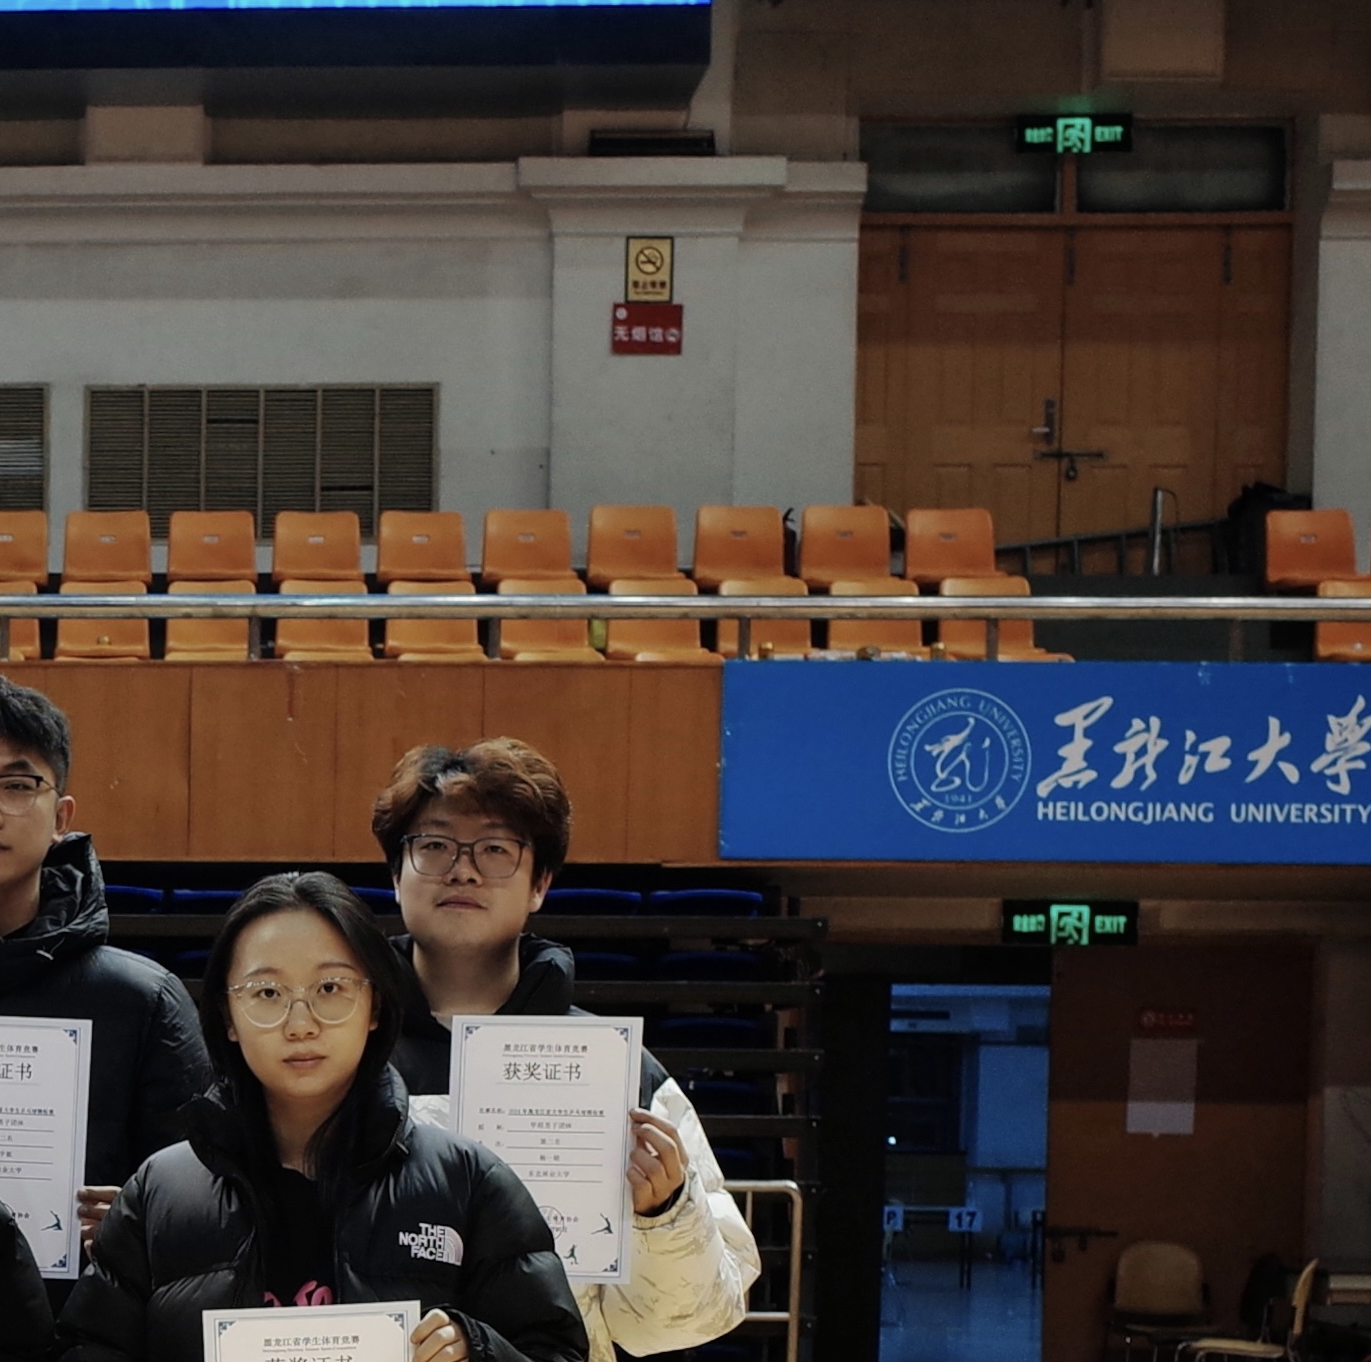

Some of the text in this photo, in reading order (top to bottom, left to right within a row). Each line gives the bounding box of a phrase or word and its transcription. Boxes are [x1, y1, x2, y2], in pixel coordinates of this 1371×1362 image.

[1037, 800, 1371, 825] HEILONGJIANG UNIVERSITY
[1094, 915, 1128, 934] EXIT
[504, 1044, 588, 1053] 黑龙江省学生体育竞赛
[503, 1062, 581, 1081] 获奖证书
[956, 1211, 977, 1228] 17
[419, 1222, 445, 1237] THE
[398, 1231, 445, 1250] NORTH
[411, 1246, 444, 1262] FACE
[264, 1335, 360, 1347] 黑龙江省学生体育竞赛
